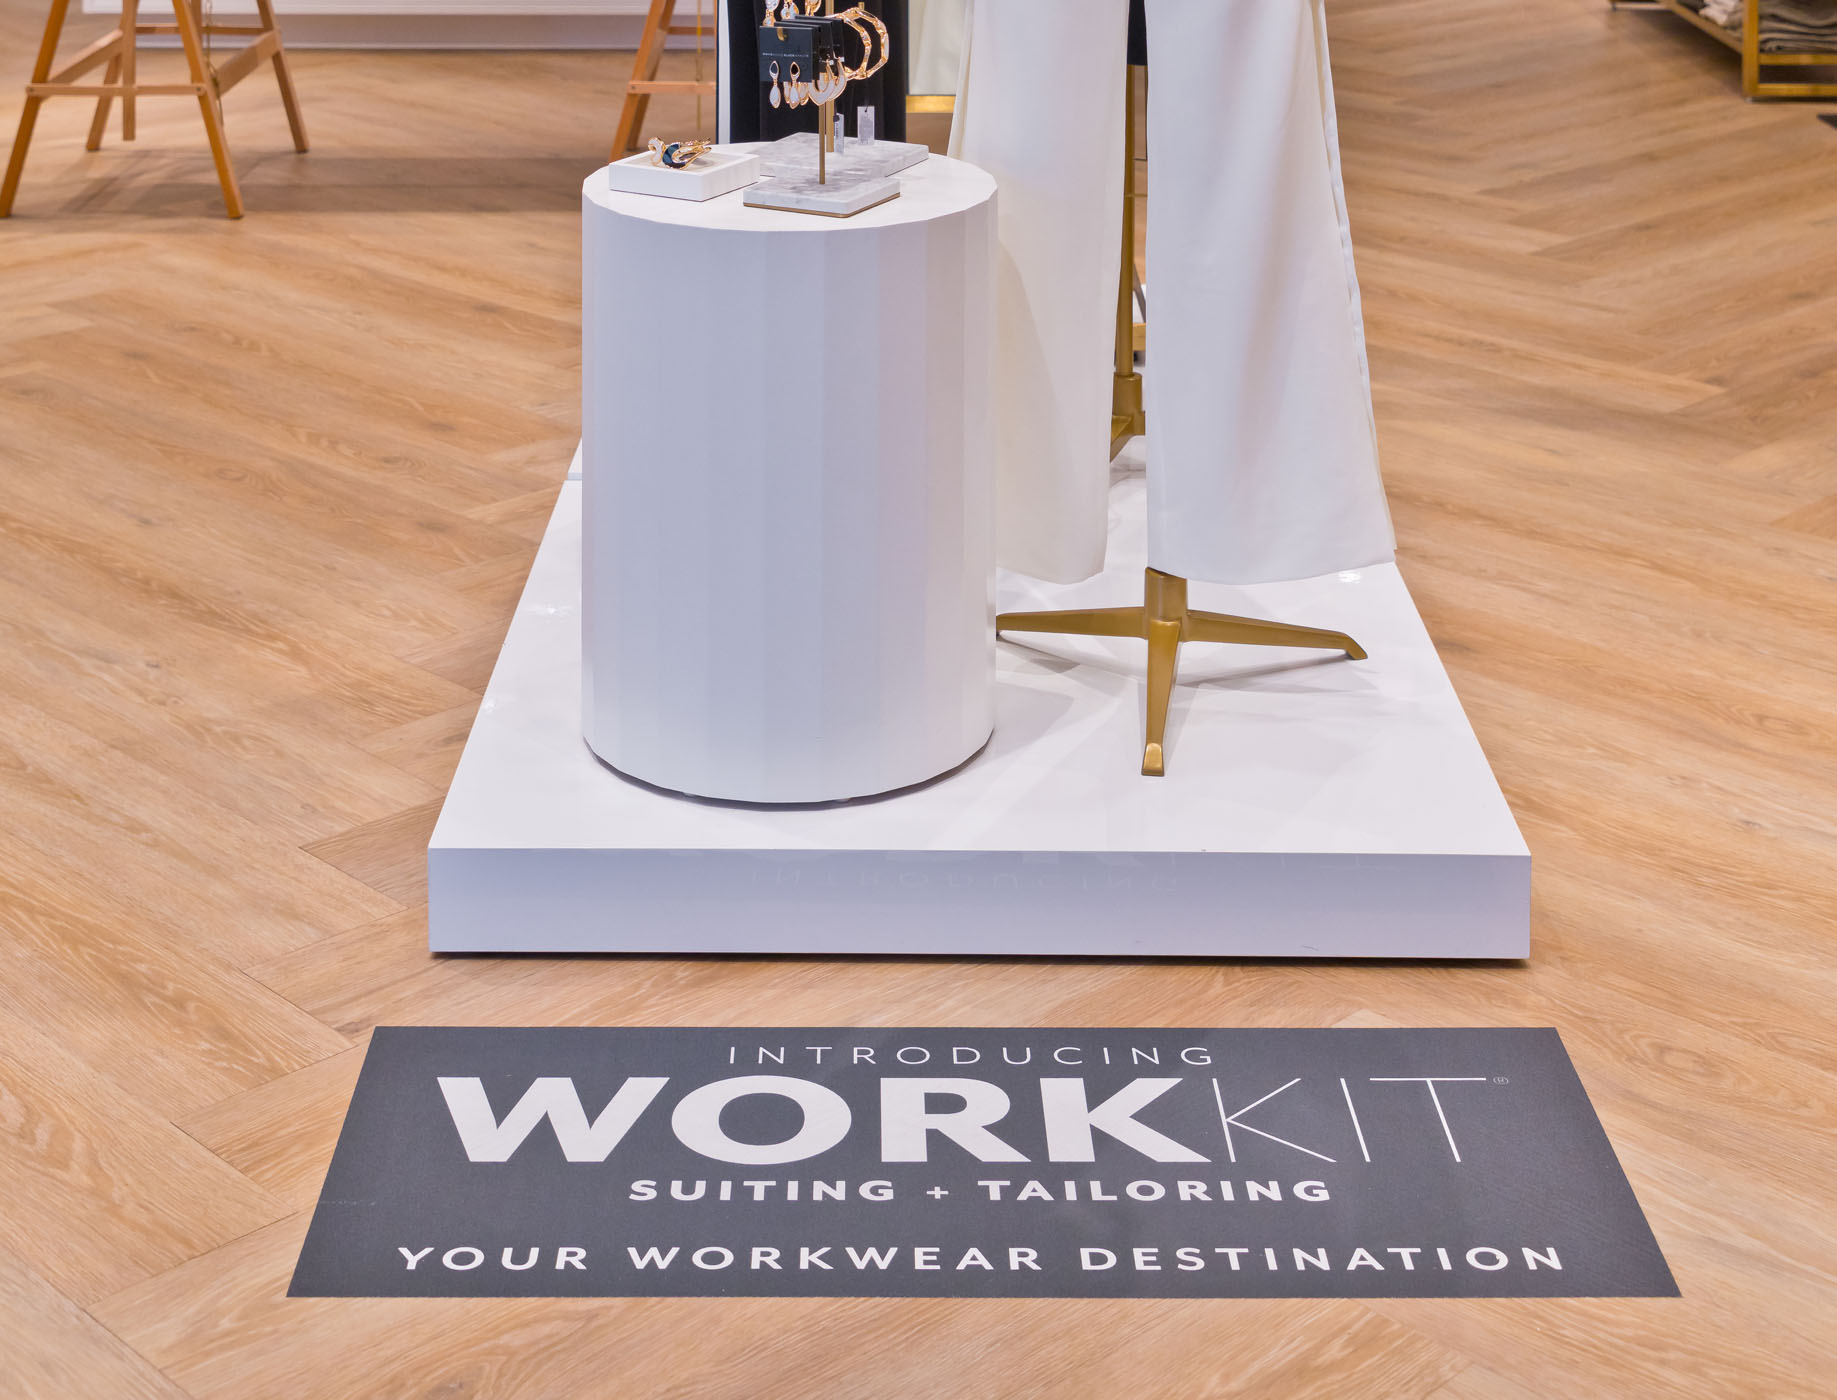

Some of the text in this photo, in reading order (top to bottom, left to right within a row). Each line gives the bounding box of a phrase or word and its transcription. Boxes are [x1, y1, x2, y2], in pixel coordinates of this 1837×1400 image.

[729, 1046, 1213, 1066] INTRODUCING
[628, 1180, 894, 1202] SUITING
[977, 1180, 1331, 1202] TAILORING
[397, 1246, 1563, 1271] YOUR WORKWEAR DESTINATION
